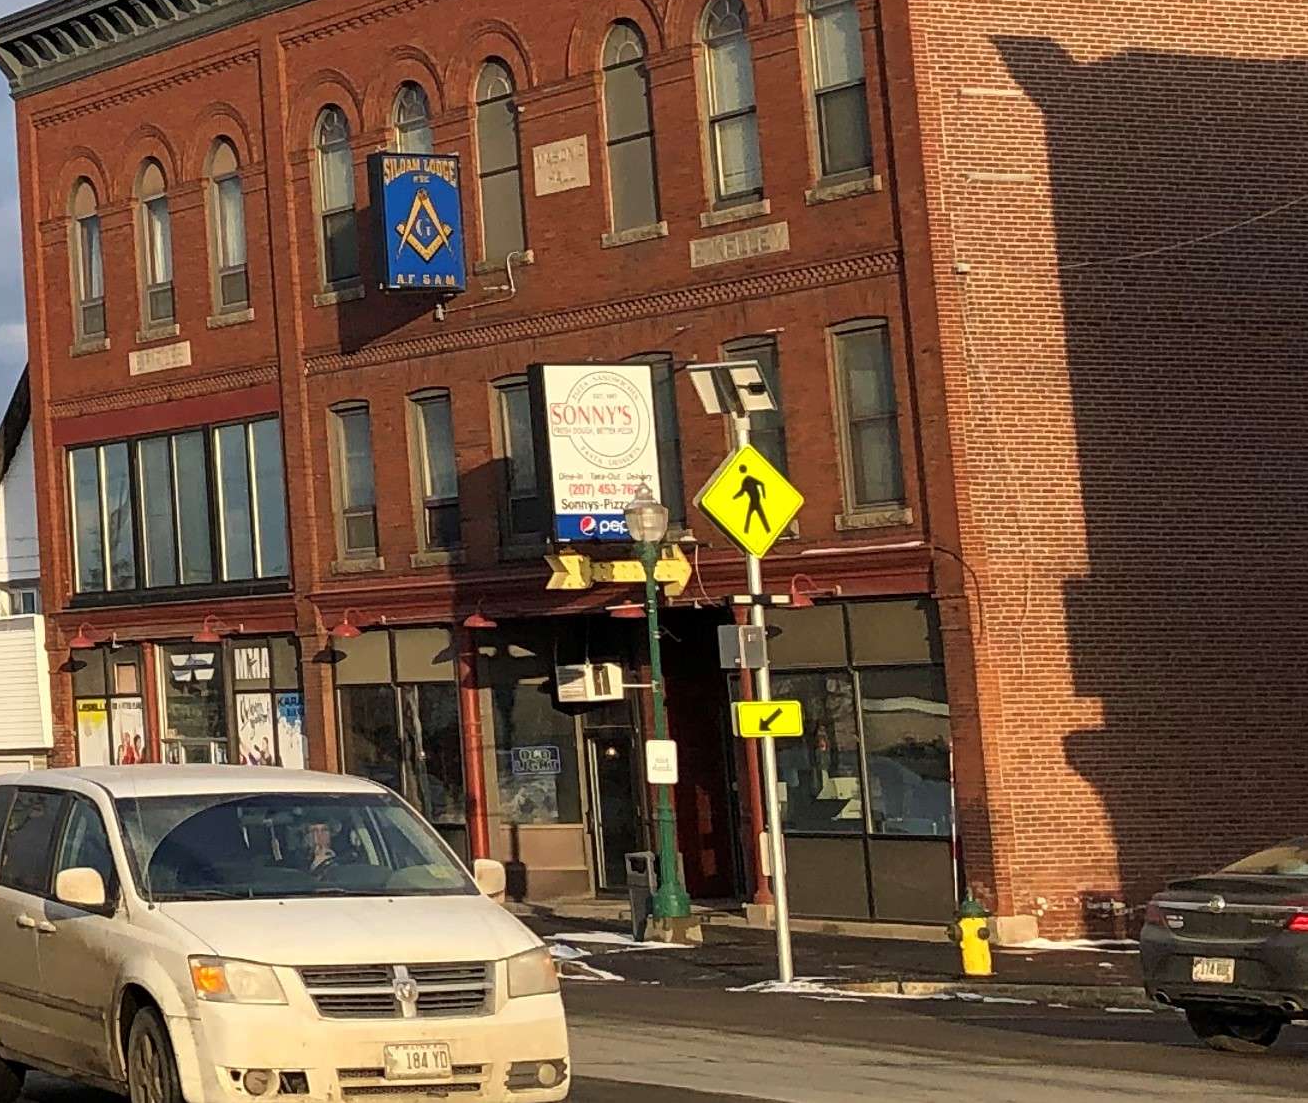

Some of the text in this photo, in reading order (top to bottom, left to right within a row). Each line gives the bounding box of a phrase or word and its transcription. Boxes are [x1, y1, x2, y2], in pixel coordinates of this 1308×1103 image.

[424, 158, 457, 188] LODGE
[551, 405, 632, 425] SONNY'S
[569, 484, 594, 497] (207)
